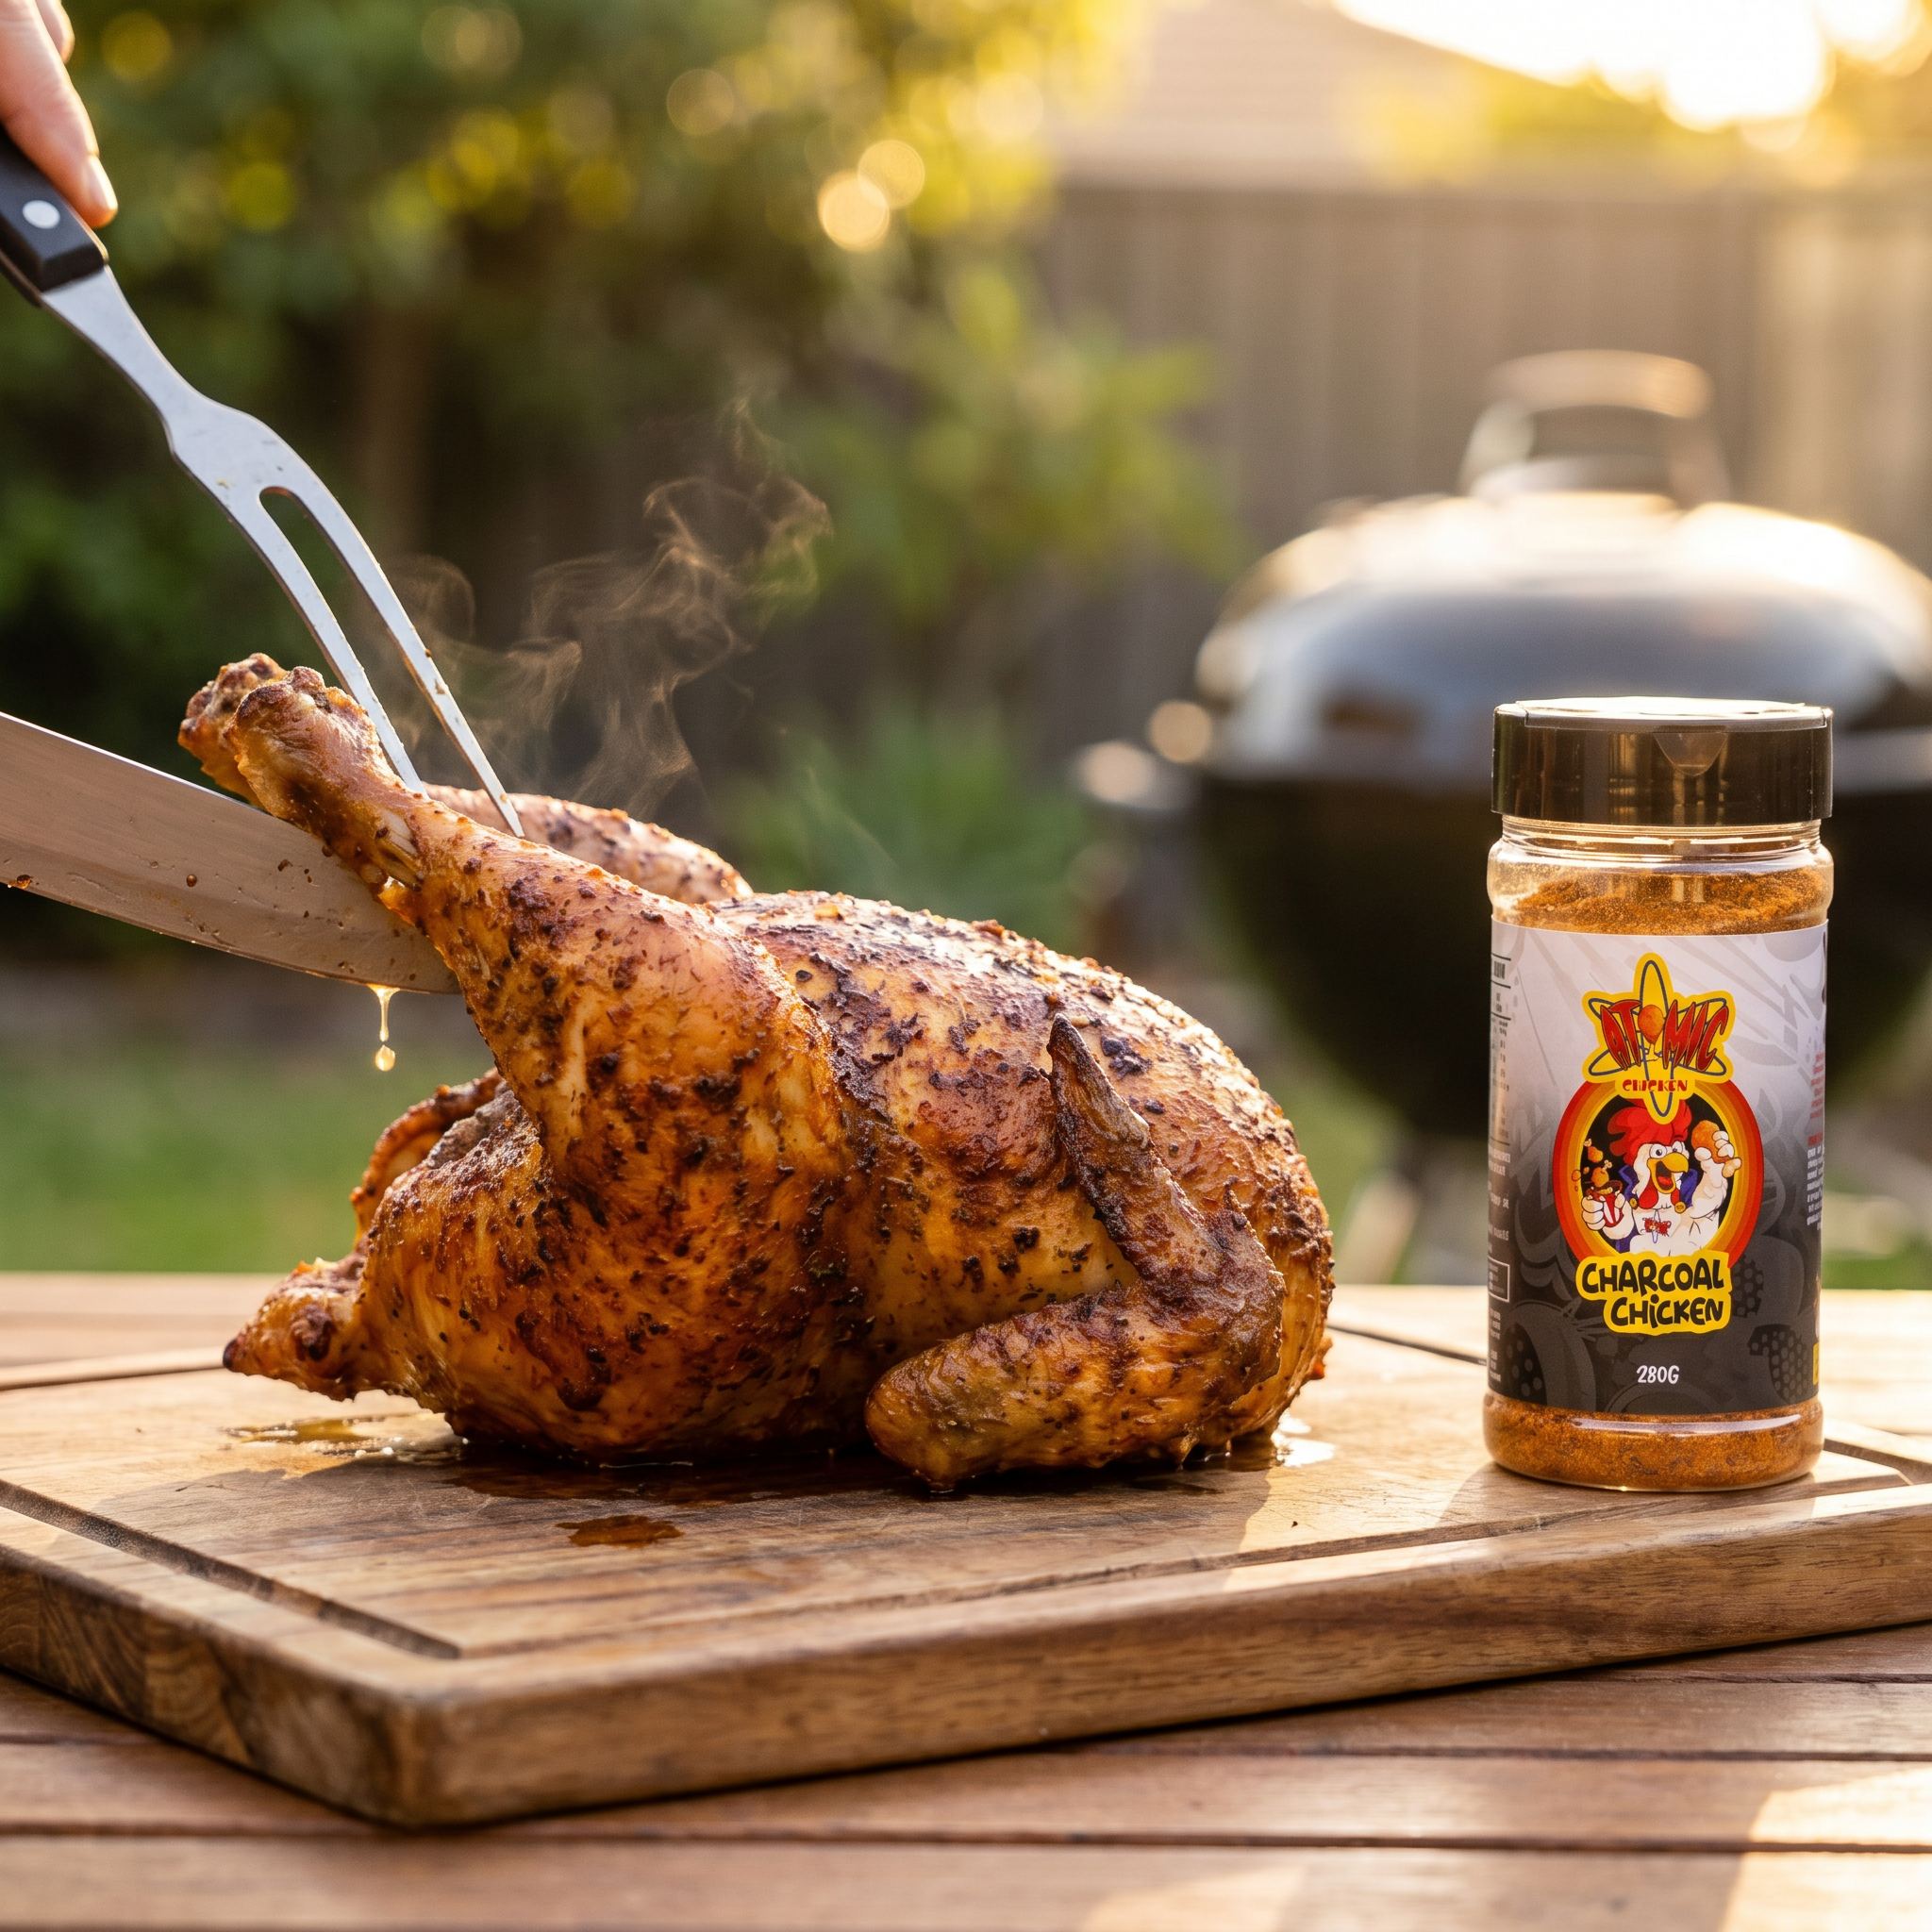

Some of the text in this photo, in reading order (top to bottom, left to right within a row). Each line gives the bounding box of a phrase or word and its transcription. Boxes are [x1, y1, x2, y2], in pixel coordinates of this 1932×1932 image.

[1600, 999, 1729, 1071] ATOMIC
[1582, 1257, 1724, 1297] CHARCOAL
[1636, 1365, 1680, 1384] 280G
